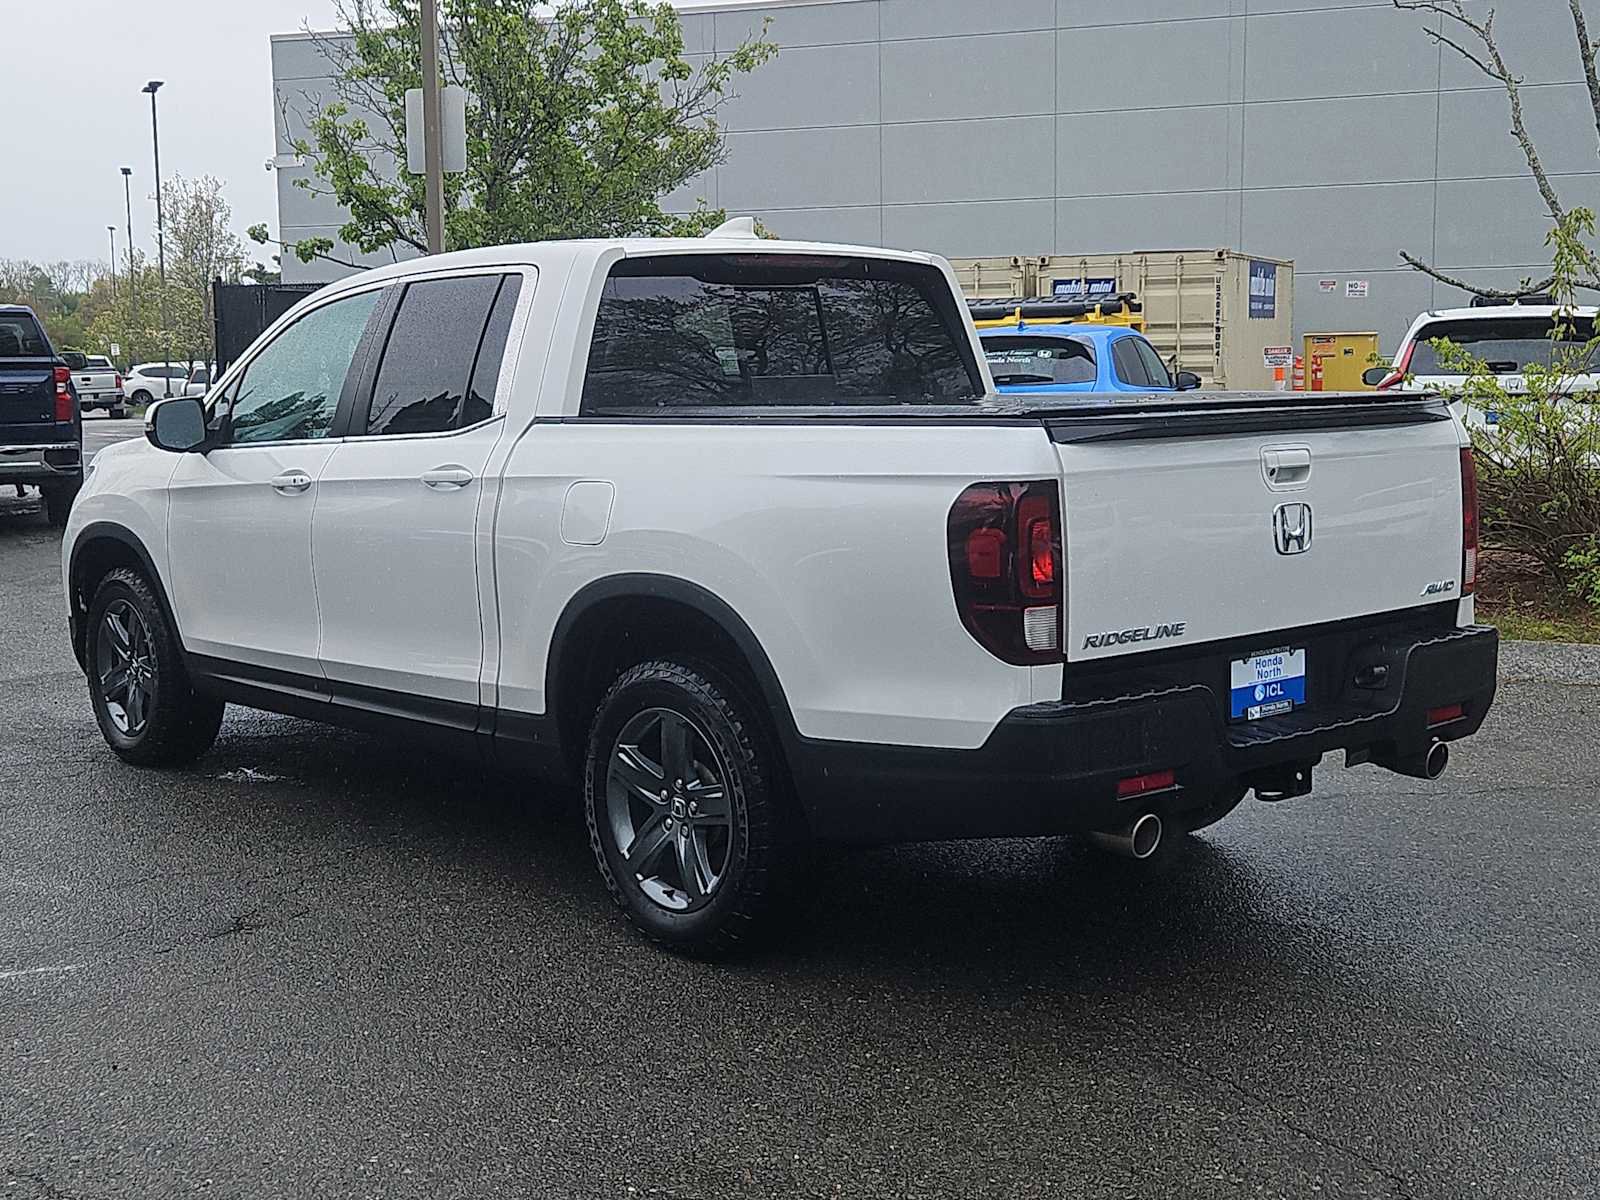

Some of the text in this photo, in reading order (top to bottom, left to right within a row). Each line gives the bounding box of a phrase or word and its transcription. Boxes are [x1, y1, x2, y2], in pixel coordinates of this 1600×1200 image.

[1054, 279, 1089, 294] mobie
[1419, 579, 1455, 597] AWD
[1082, 622, 1187, 651] RIDGELINE
[1255, 655, 1283, 669] Honda
[1257, 667, 1282, 680] North
[1266, 683, 1284, 697] ICL
